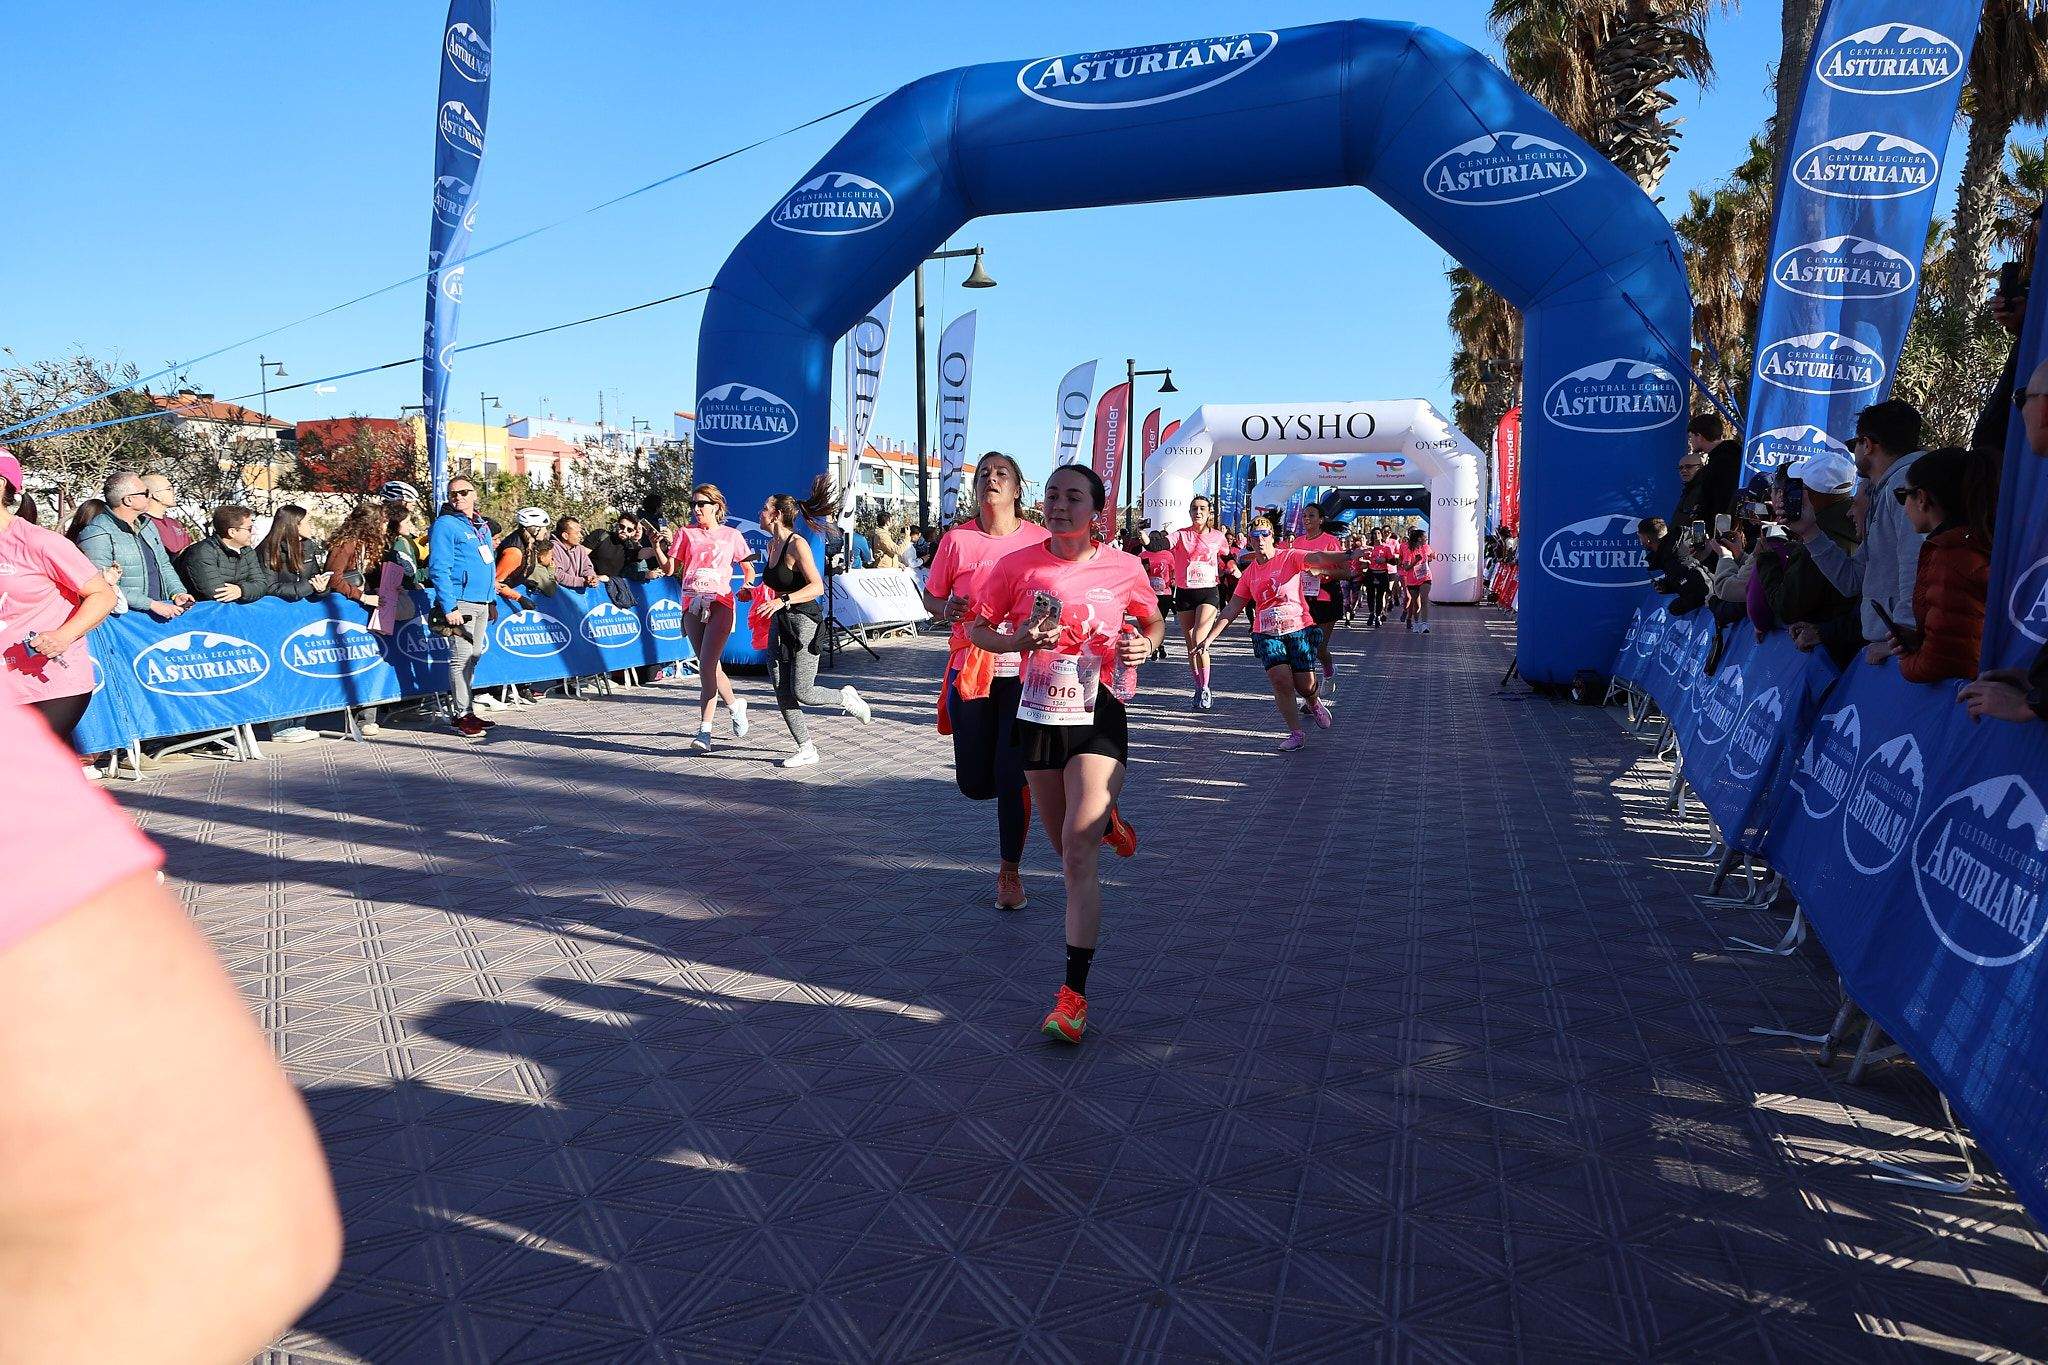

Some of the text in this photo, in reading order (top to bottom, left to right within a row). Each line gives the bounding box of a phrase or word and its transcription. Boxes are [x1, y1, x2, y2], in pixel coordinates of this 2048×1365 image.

[1849, 47, 1949, 56] CENTRAL LECHERA
[1033, 38, 1256, 90] ASTURIANA
[1824, 50, 1950, 77] ASTURIANA
[1458, 151, 1569, 169] CENTRAL LECHERA
[1802, 155, 1927, 185] ASTURIANA
[1828, 154, 1927, 165] CENTRAL LECHERA
[1436, 161, 1578, 193] ASTURIANA
[796, 191, 880, 202] CENTRAL LECHERA
[776, 199, 884, 222] ASTURIANA
[1780, 256, 1902, 289] ASTURIANA
[1806, 256, 1902, 270] CENTRAL LECHERA
[1762, 351, 1874, 384] ASTURIANA
[706, 404, 787, 415] CENTRAL LECHERA
[1552, 389, 1678, 417] ASTURIANA
[697, 406, 790, 433] ASTURIANA
[1240, 411, 1377, 442] OYSHO
[1102, 405, 1119, 478] Santander
[1164, 445, 1203, 456] OYSHO
[1415, 439, 1459, 451] OYSHO
[1769, 442, 1813, 453] CENTRAL
[1436, 552, 1476, 562] OYSHO
[1547, 541, 1651, 569] ASTURIA
[503, 627, 568, 648] ASTURIANA
[587, 618, 638, 640] ASTURIANA
[292, 643, 382, 668] ASTURIANA
[146, 656, 264, 687] ASTURIANA
[1047, 685, 1077, 699] 016
[1026, 710, 1051, 720] OYSHO
[1920, 817, 2040, 945] ASTURIANA
